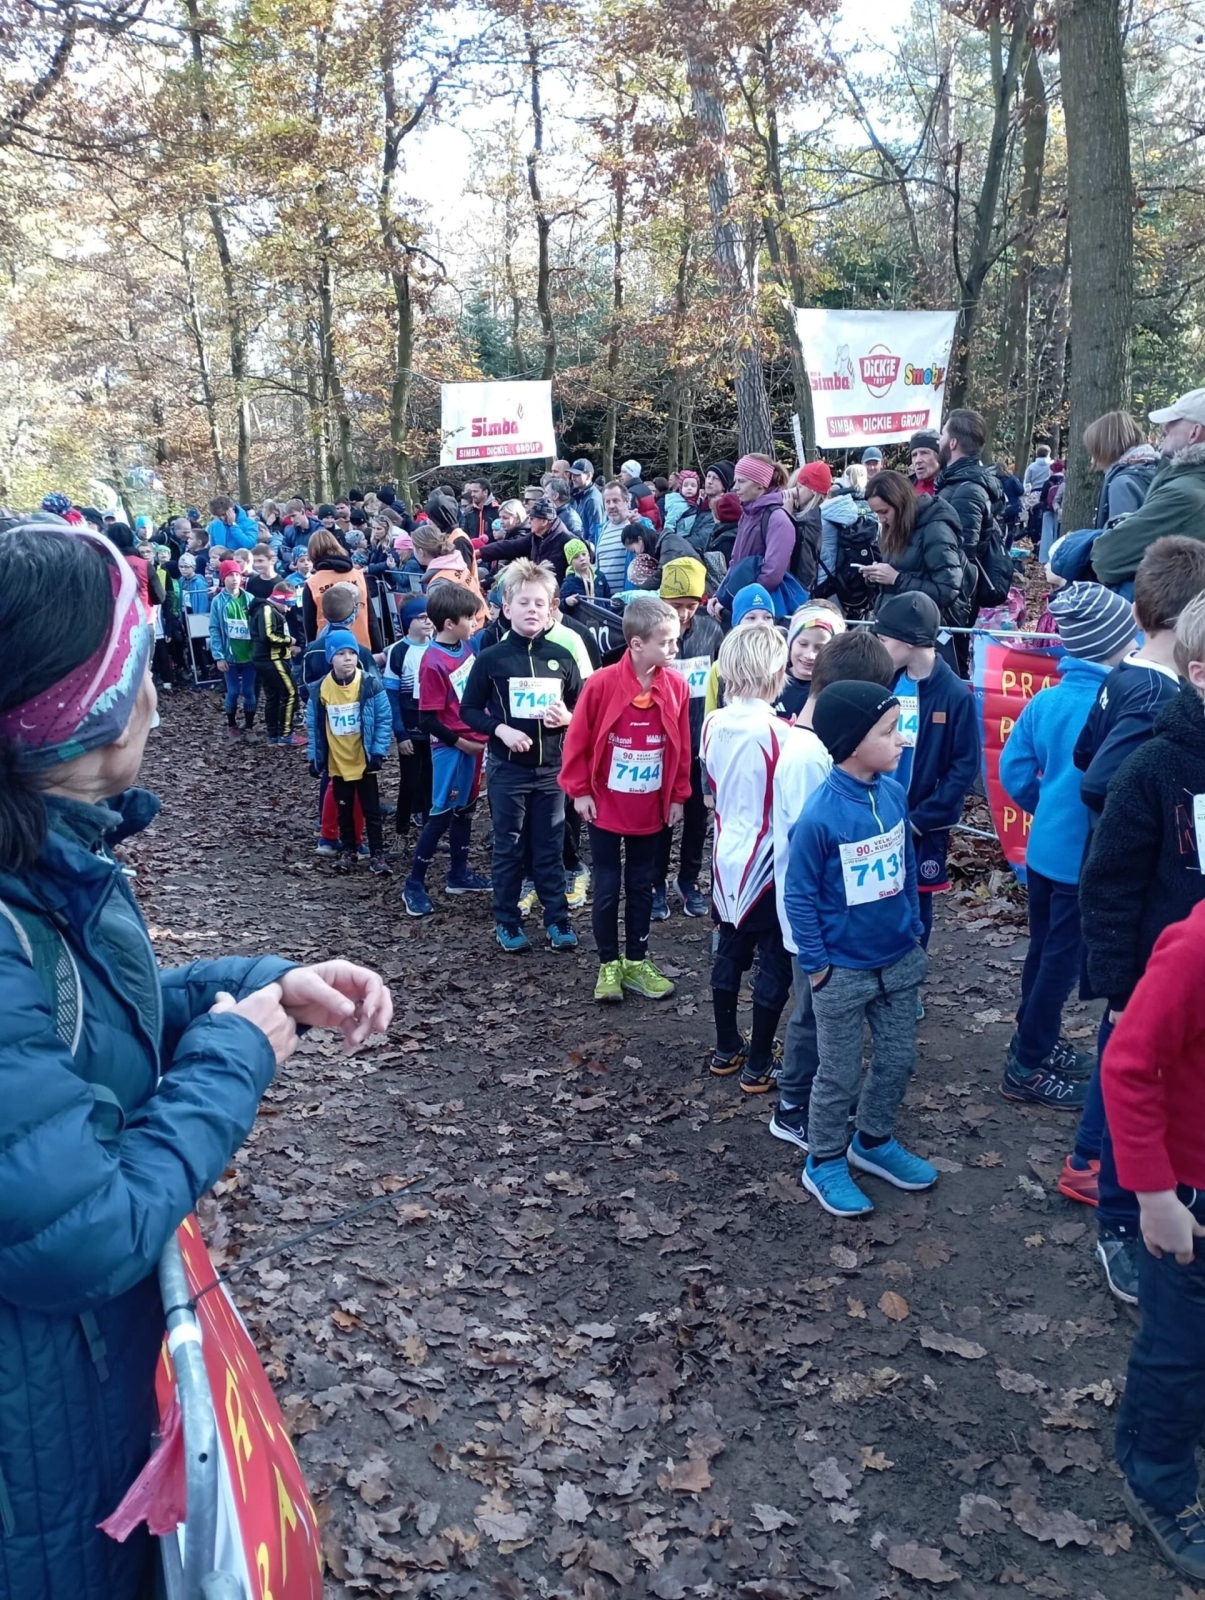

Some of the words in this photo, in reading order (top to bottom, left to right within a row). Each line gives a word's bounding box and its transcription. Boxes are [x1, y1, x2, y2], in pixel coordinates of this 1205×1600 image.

[810, 371, 850, 391] Simba
[471, 417, 519, 437] Simba
[829, 419, 855, 434] SIMBA
[862, 416, 893, 431] DICKIE
[901, 413, 926, 427] GROUP
[459, 448, 480, 459] SIMBA
[486, 445, 509, 456] DICKIE
[515, 442, 541, 454] GROUP
[616, 763, 660, 782] 7144
[856, 844, 874, 857] 90.
